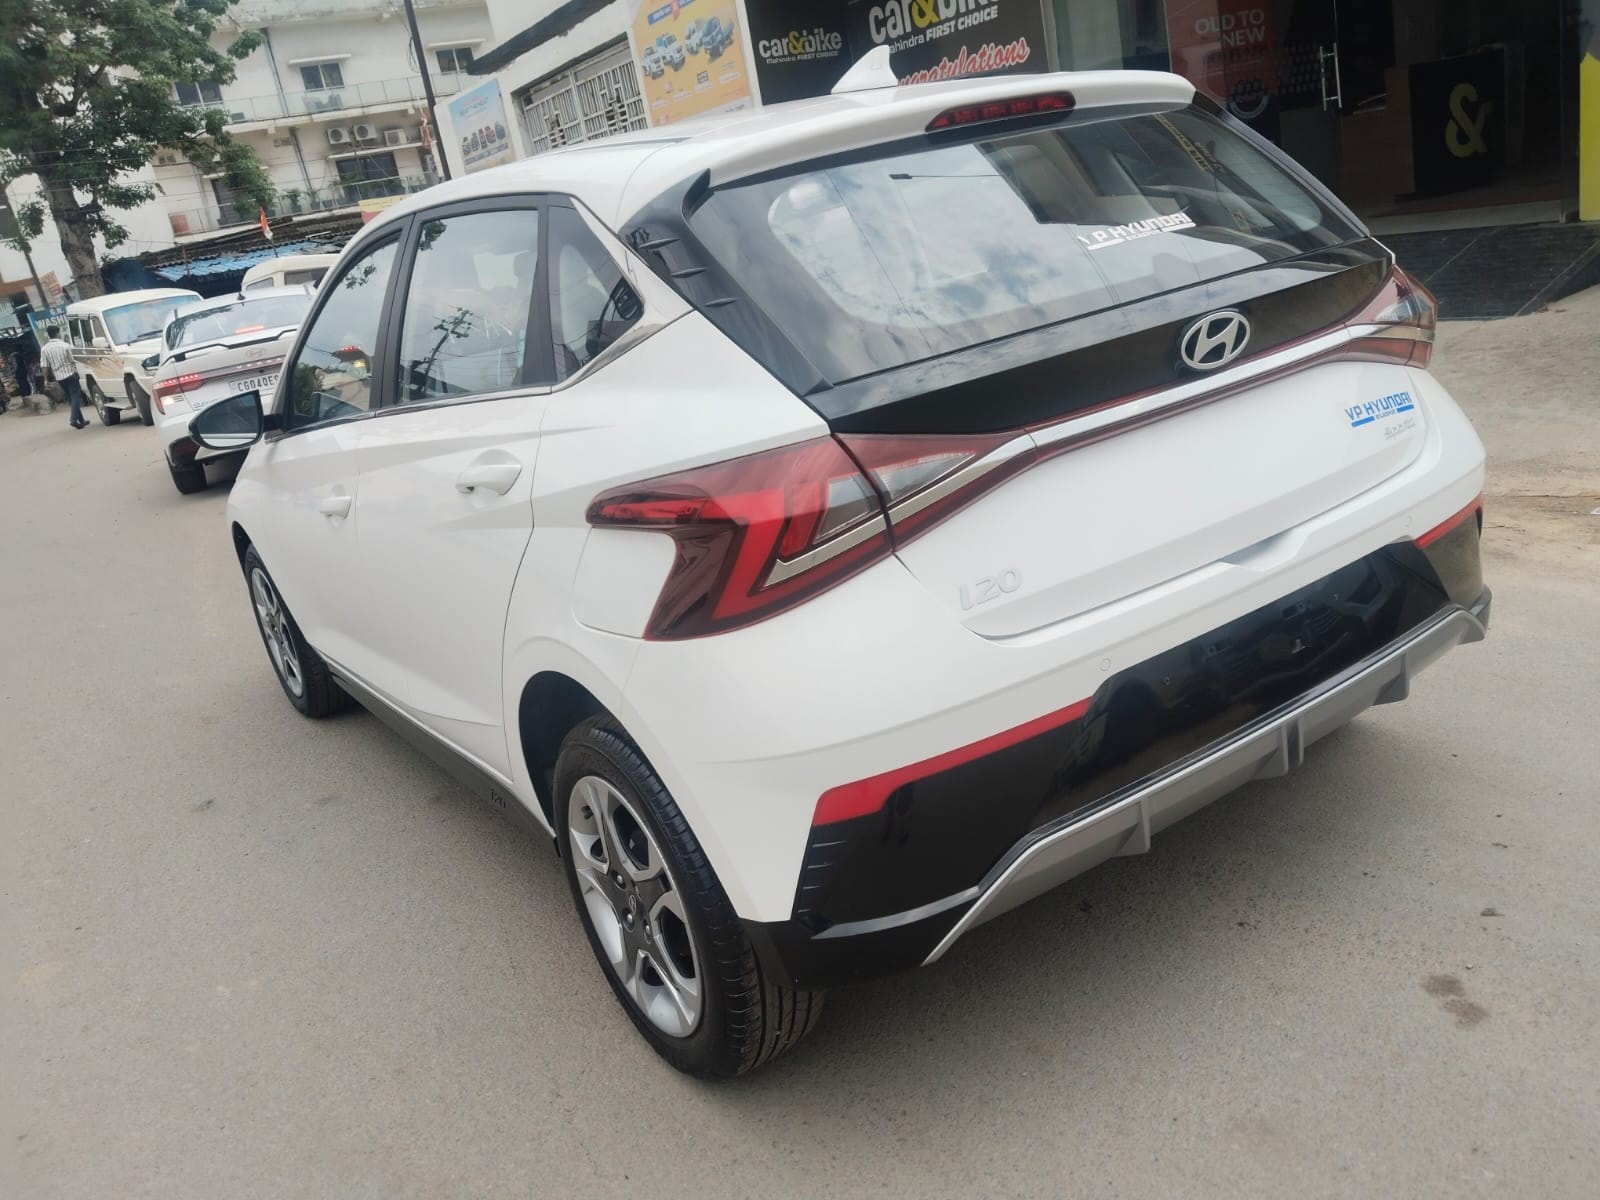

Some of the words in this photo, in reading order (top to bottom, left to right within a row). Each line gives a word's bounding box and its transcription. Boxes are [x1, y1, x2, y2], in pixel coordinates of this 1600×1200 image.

[868, 0, 999, 44] car&
[889, 34, 925, 55] ahindra
[925, 22, 956, 42] FIRST
[957, 5, 998, 31] CHOICE
[1194, 14, 1236, 34] OLD
[1237, 8, 1265, 27] TO
[758, 27, 842, 58] car&bike
[1222, 26, 1265, 48] NEW
[899, 37, 1031, 86] ratulations
[35, 313, 69, 329] WASHI
[1344, 405, 1363, 421] VP
[1363, 391, 1413, 416] HYUNDAI
